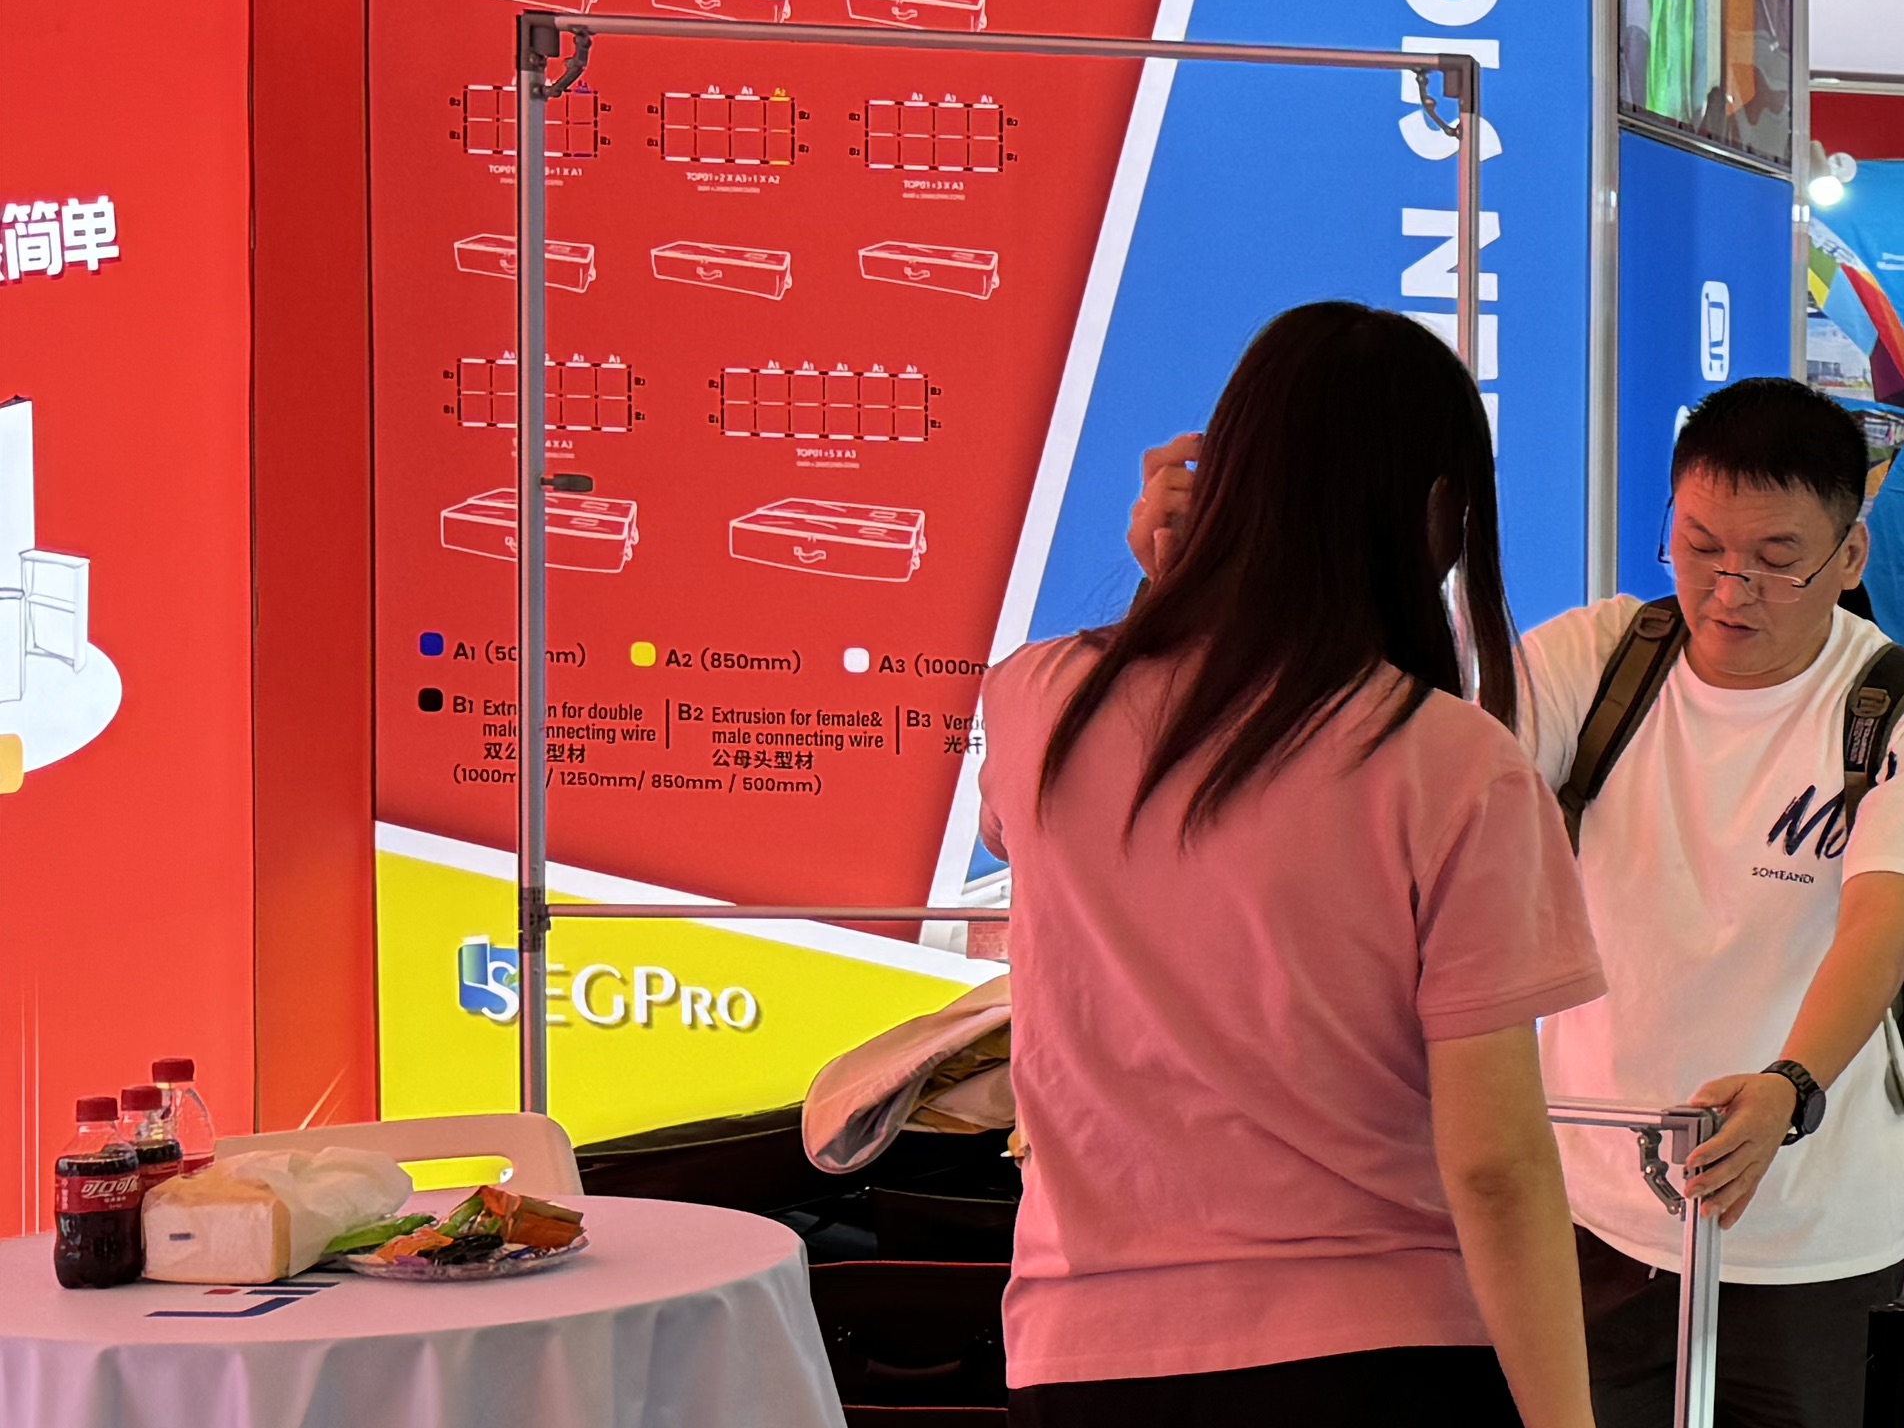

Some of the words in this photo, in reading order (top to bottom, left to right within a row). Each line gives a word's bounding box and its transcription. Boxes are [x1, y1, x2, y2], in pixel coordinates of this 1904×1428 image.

[0, 195, 120, 282] 简单
[453, 642, 476, 661] A1
[666, 649, 693, 668] A2
[701, 647, 801, 674] (850mm)
[879, 655, 906, 674] A3
[453, 695, 474, 714] B1
[562, 702, 585, 720] for
[588, 702, 643, 721] double
[678, 703, 704, 721] B2
[712, 707, 786, 726] Extrusion
[790, 709, 812, 726] for
[816, 709, 883, 727] female&
[906, 709, 932, 728] B3
[621, 725, 656, 742] wire
[712, 728, 751, 745] male
[756, 730, 844, 750] connecting
[849, 732, 885, 749] wire
[483, 742, 585, 763] 双公型材
[712, 749, 814, 770] 公母头型材
[651, 775, 723, 790] 850mm
[743, 775, 822, 796] 500mm)
